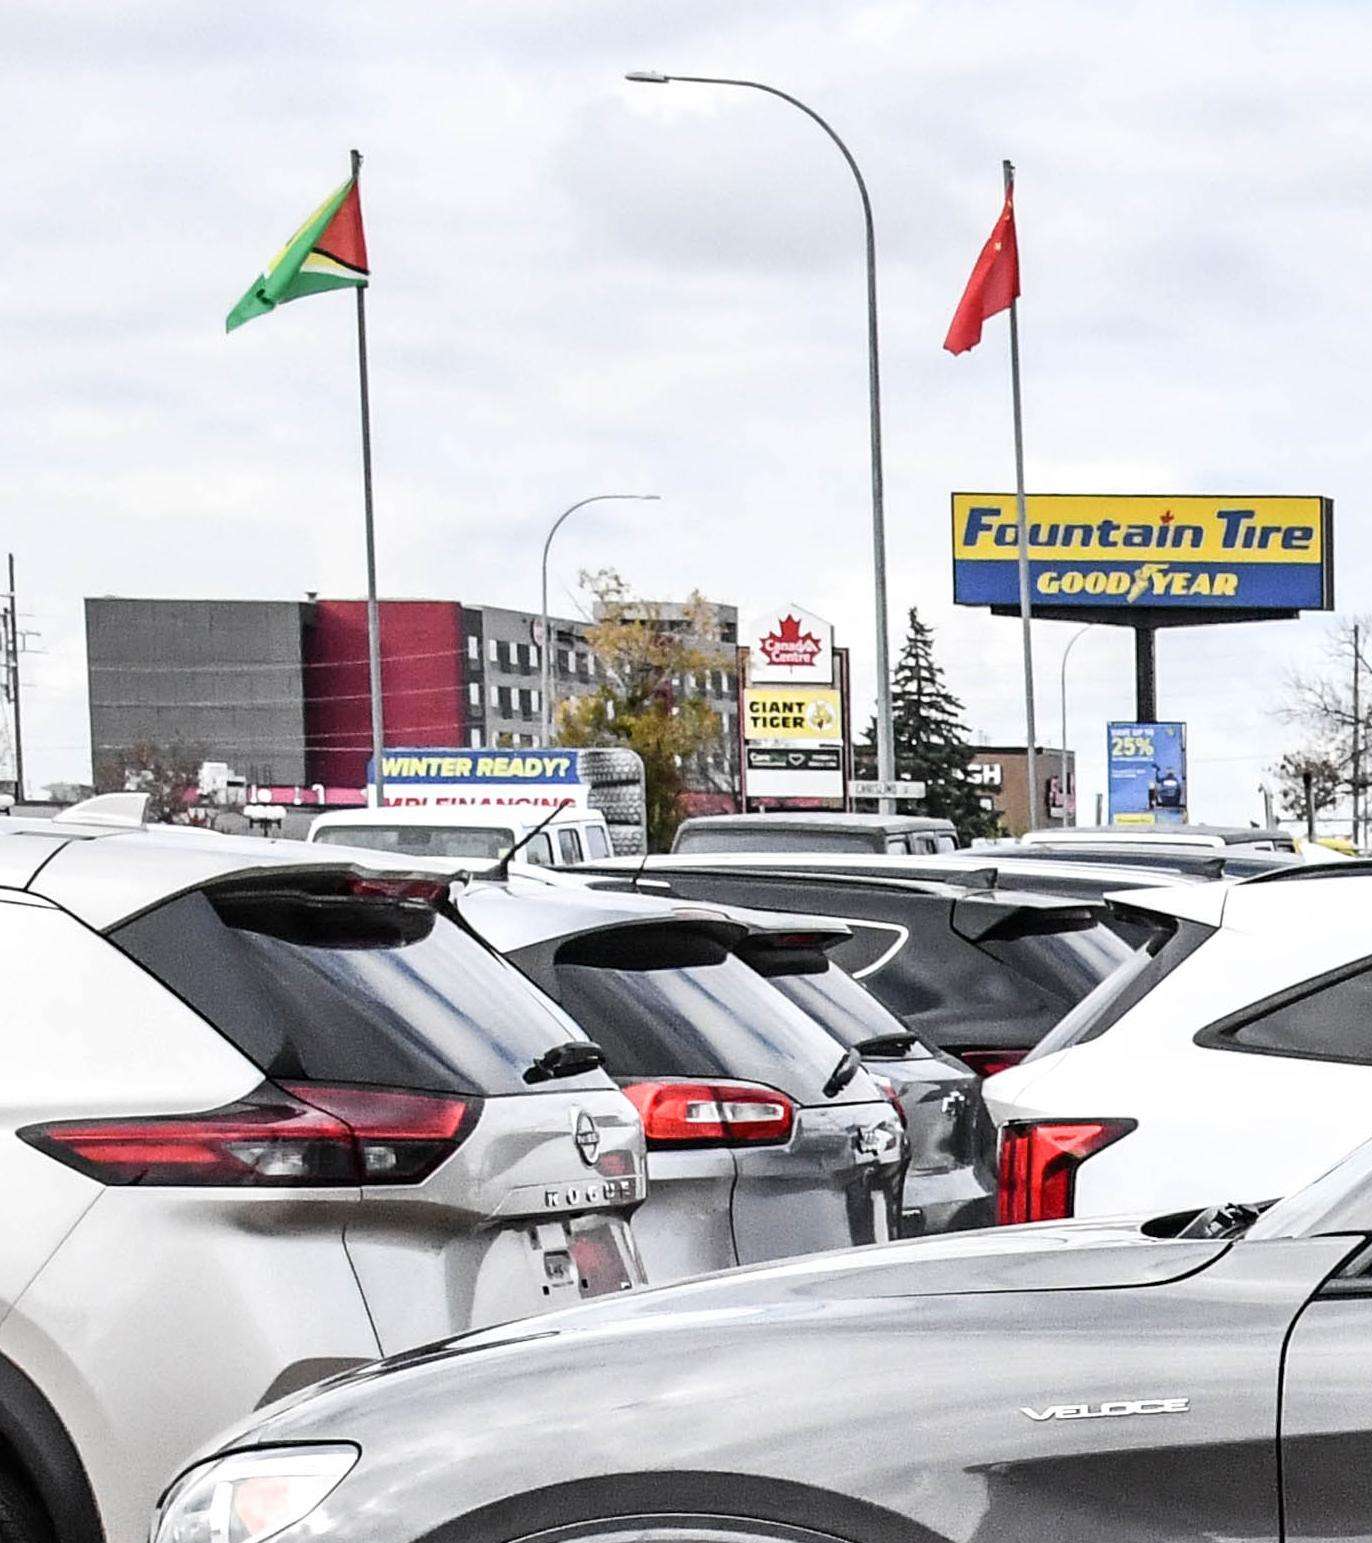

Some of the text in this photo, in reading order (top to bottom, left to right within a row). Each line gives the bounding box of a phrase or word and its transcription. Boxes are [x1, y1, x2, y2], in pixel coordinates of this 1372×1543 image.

[962, 507, 1315, 550] Fountain Tire
[1036, 564, 1239, 603] GOODYEAR
[749, 701, 806, 714] GIANT
[750, 716, 806, 729] TIGER
[1111, 736, 1156, 758] 25%
[383, 757, 569, 777] WINTER READY?
[545, 1180, 631, 1207] ROGUE
[1019, 1398, 1190, 1421] VELOCE
